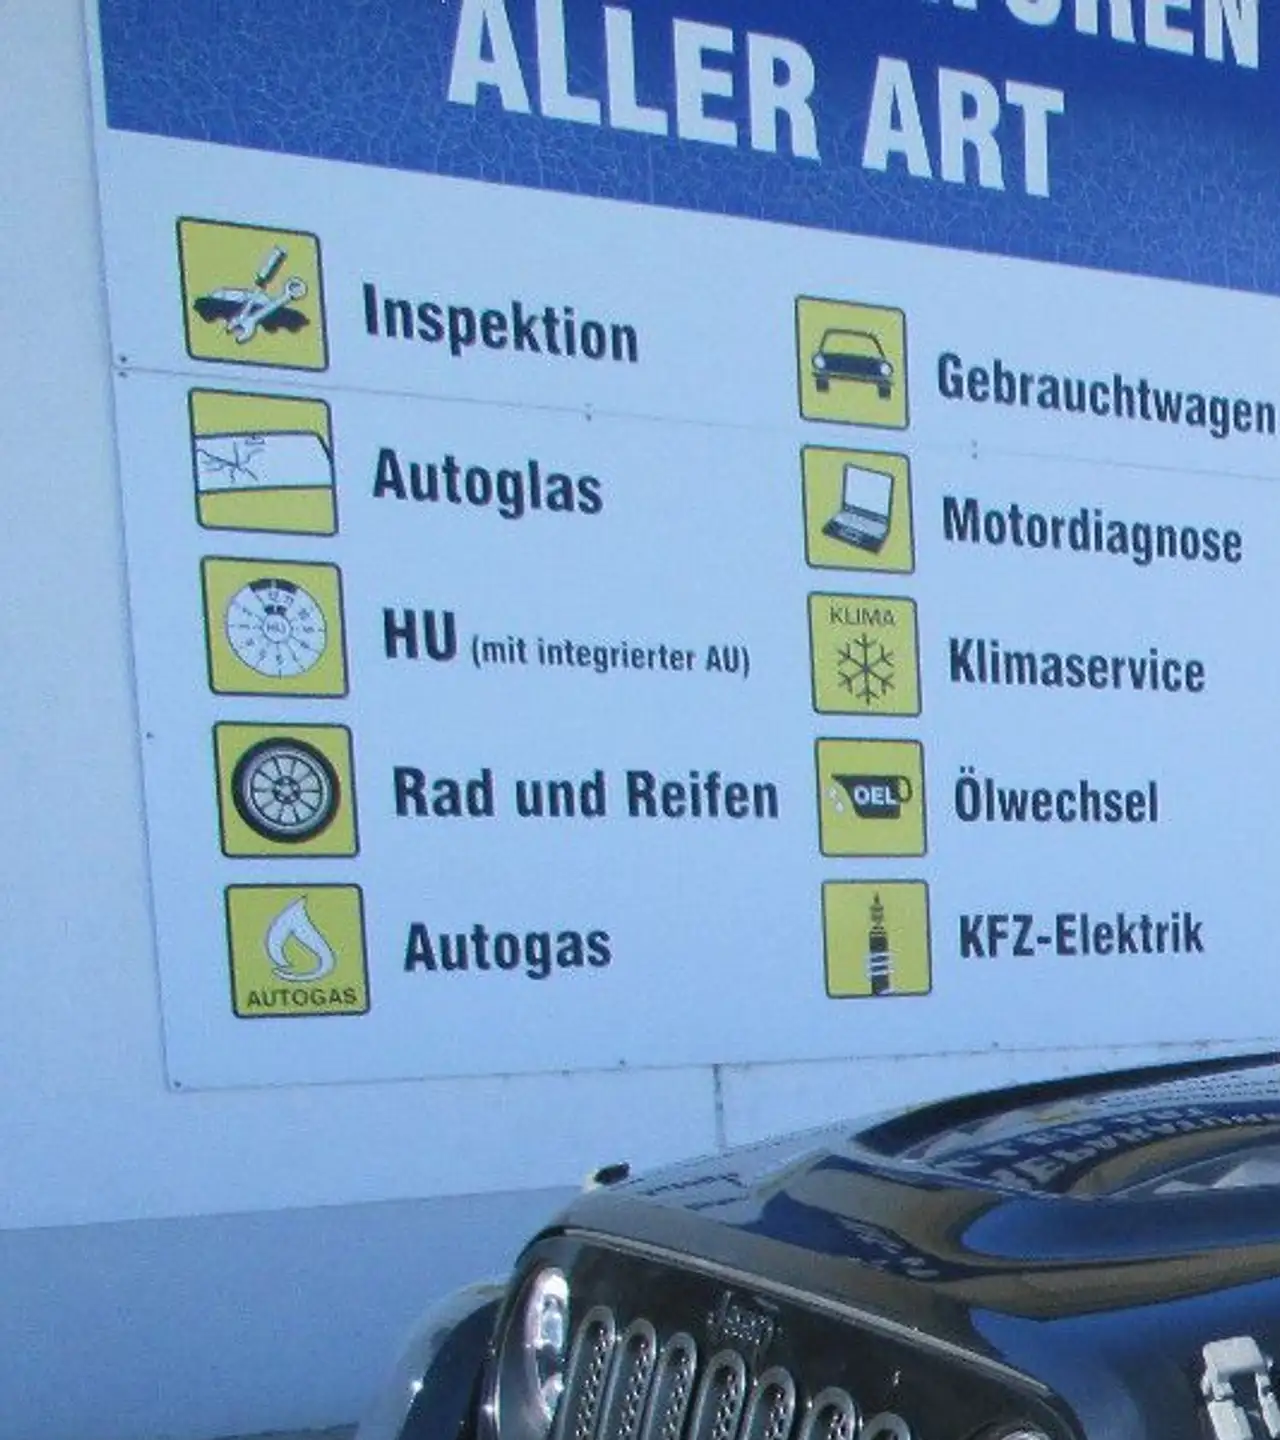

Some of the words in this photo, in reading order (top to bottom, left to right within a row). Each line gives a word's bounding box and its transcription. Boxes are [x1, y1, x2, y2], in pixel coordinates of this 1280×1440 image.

[447, 0, 821, 160] ALLER
[862, 56, 1064, 198] ART
[363, 283, 638, 363] Inspektion
[938, 353, 1276, 438] Gebrauchtwagen
[373, 448, 603, 519] Autoglas
[943, 496, 1242, 566] Motordiagnose
[383, 608, 457, 661] HU
[472, 634, 527, 668] (mit
[538, 637, 694, 674] integrierter
[705, 644, 750, 679] AU)
[829, 606, 896, 627] KLIMA
[949, 637, 1205, 692] Klimaservice
[394, 766, 494, 817] Rad
[515, 769, 606, 817] und
[627, 770, 779, 818] Reifen
[853, 785, 896, 806] OEL
[955, 766, 1158, 822] Ölwechsel
[404, 922, 611, 980] Autogas
[959, 912, 1204, 958] KFZ-Elektrik
[247, 986, 357, 1008] AUTOGAS
